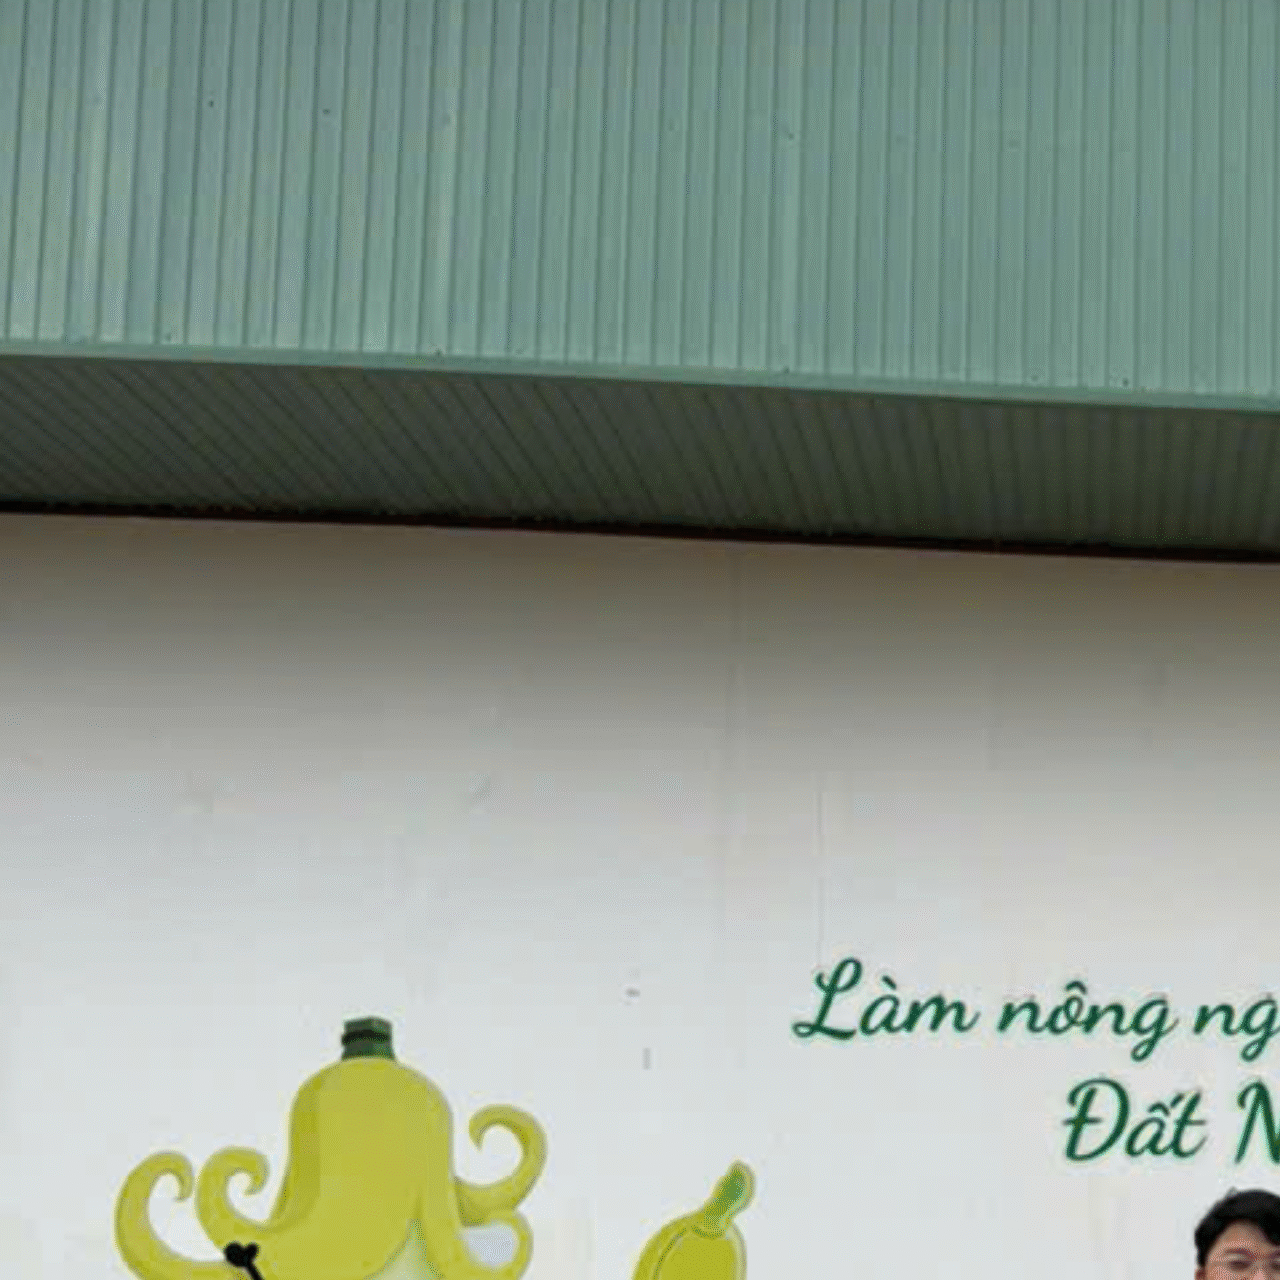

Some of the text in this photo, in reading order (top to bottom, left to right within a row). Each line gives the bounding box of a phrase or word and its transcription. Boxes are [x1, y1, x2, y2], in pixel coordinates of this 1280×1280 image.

[791, 957, 979, 1041] Làm
[995, 981, 1177, 1063] nông
[1062, 1078, 1207, 1164] Đất
